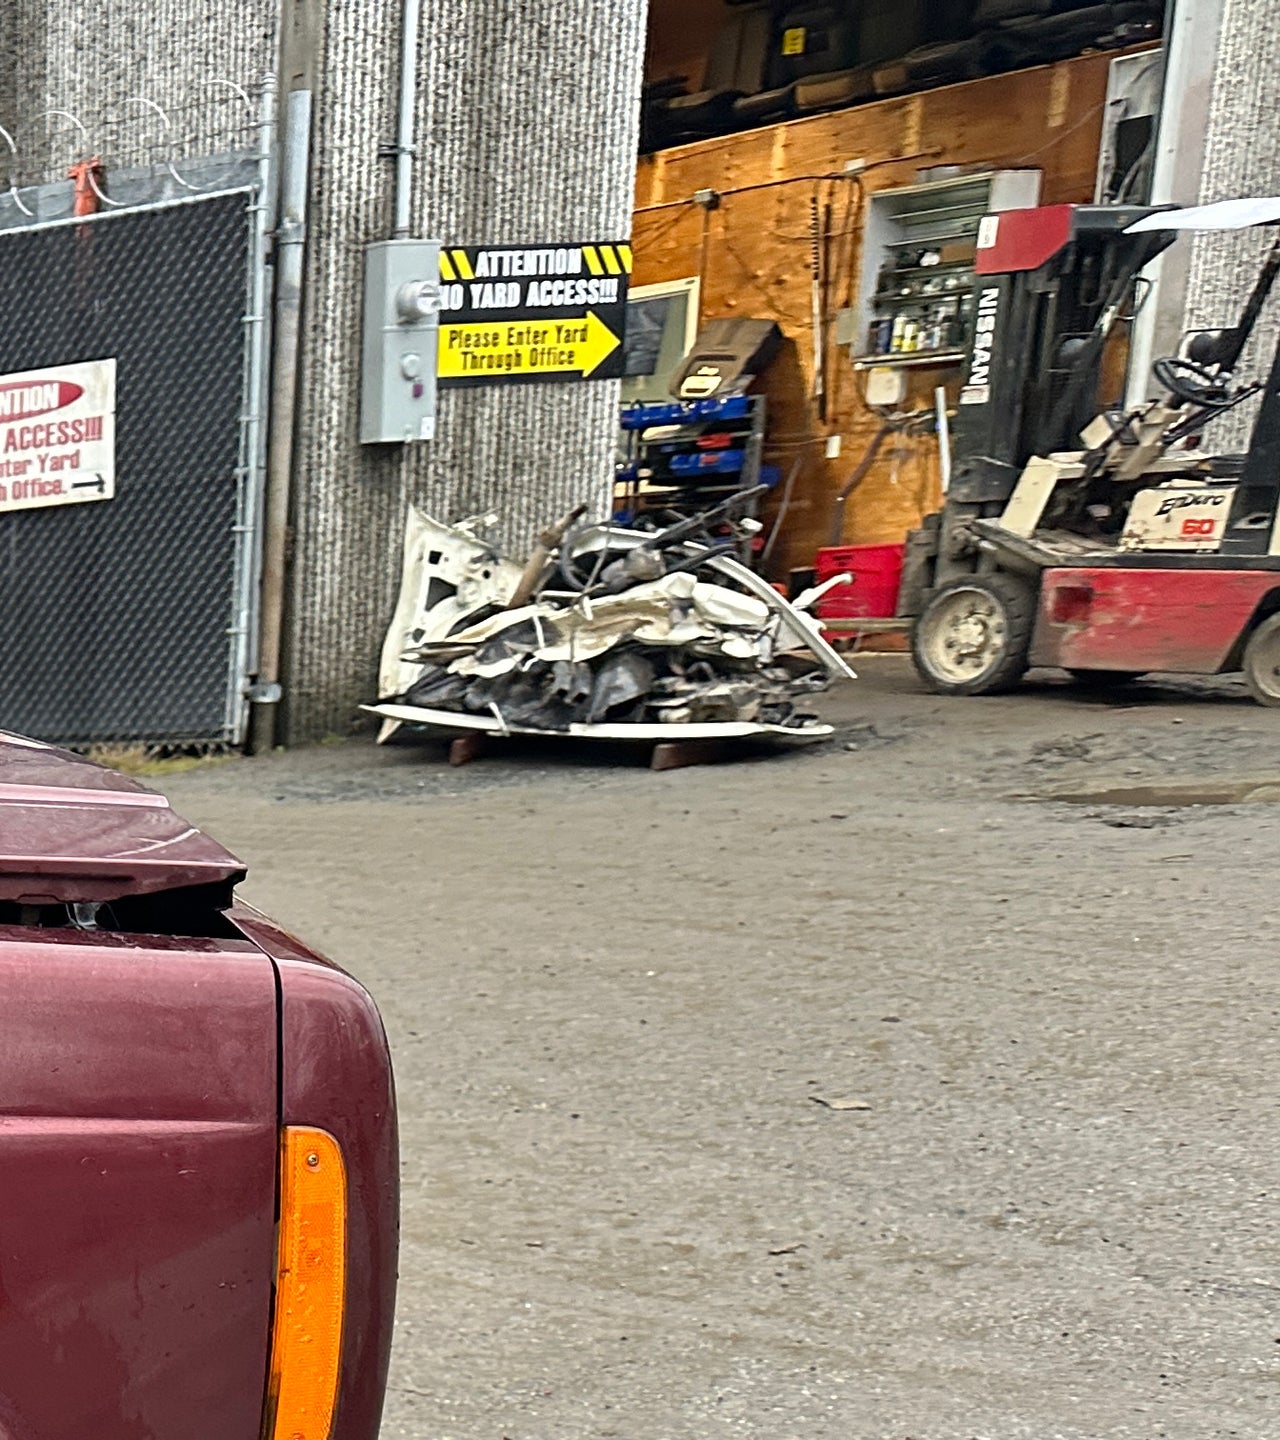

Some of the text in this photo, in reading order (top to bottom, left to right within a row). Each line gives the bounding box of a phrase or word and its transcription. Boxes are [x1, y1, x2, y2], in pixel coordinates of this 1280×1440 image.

[474, 248, 583, 278] ATTENTION
[469, 281, 521, 310] YARD
[525, 278, 619, 306] ACCESS!!!
[448, 324, 589, 350] Please Enter Yard
[968, 287, 1000, 386] NISSAN
[460, 348, 576, 372] Through Office
[2, 415, 104, 454] ACCESS!!!
[36, 449, 81, 473] Yard
[1181, 517, 1216, 535] 60
